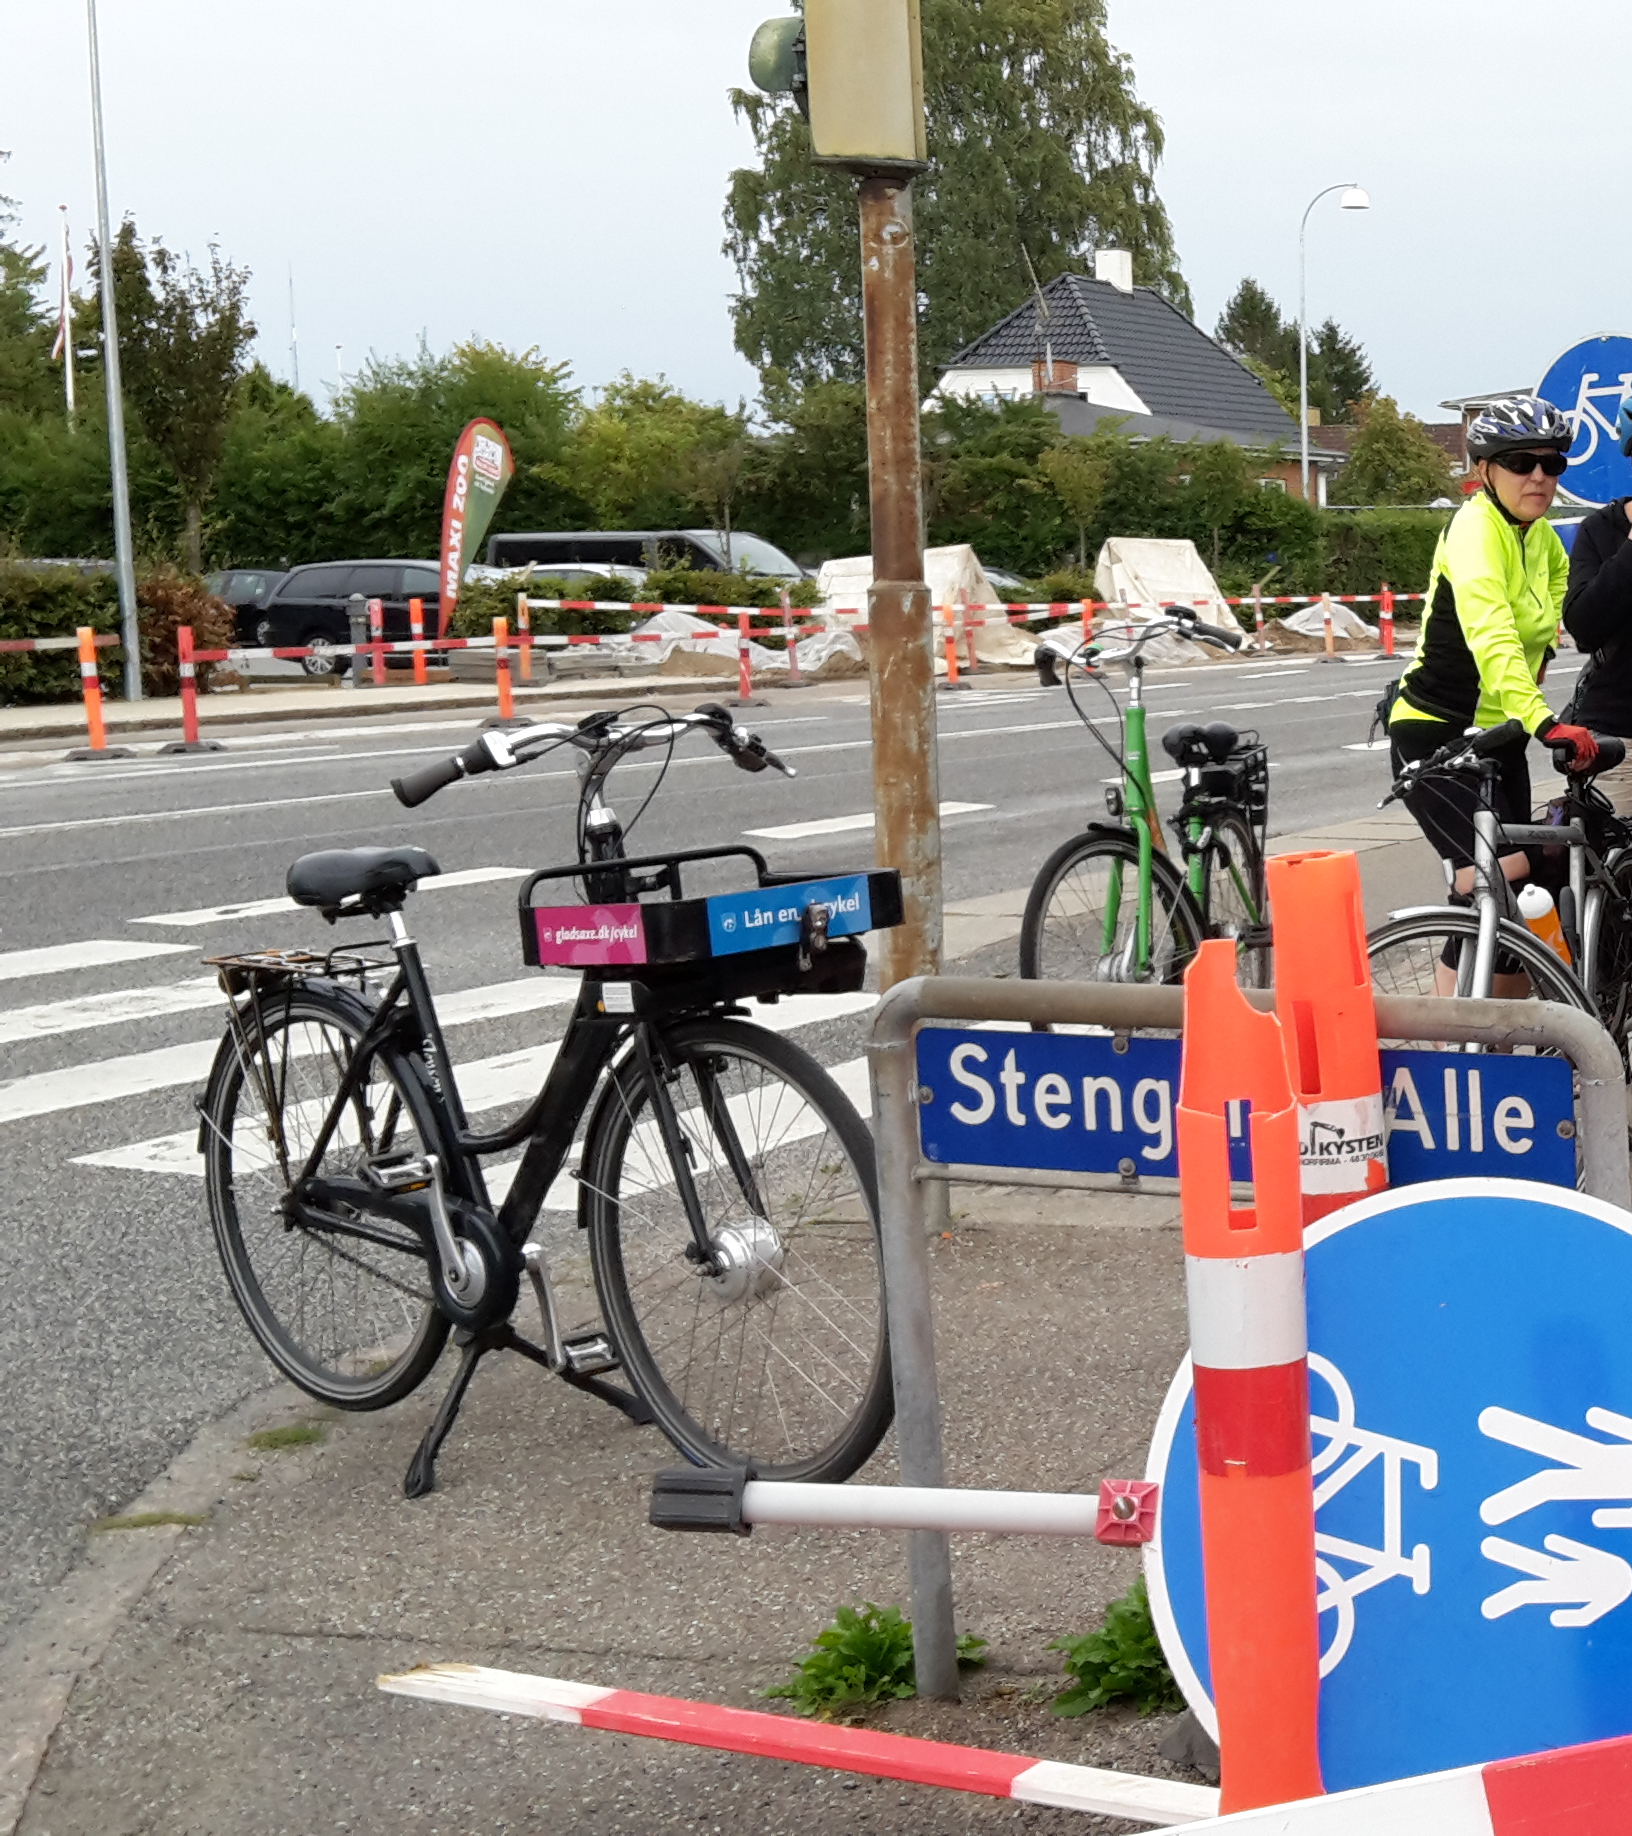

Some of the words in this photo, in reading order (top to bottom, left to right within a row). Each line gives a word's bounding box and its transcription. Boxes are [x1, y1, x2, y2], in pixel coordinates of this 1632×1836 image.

[452, 454, 469, 512] ZOO
[446, 519, 462, 599] MAXI
[744, 908, 773, 928] Lån
[778, 907, 798, 922] en
[950, 1043, 1242, 1161] Steng
[1384, 1067, 1535, 1154] Alle
